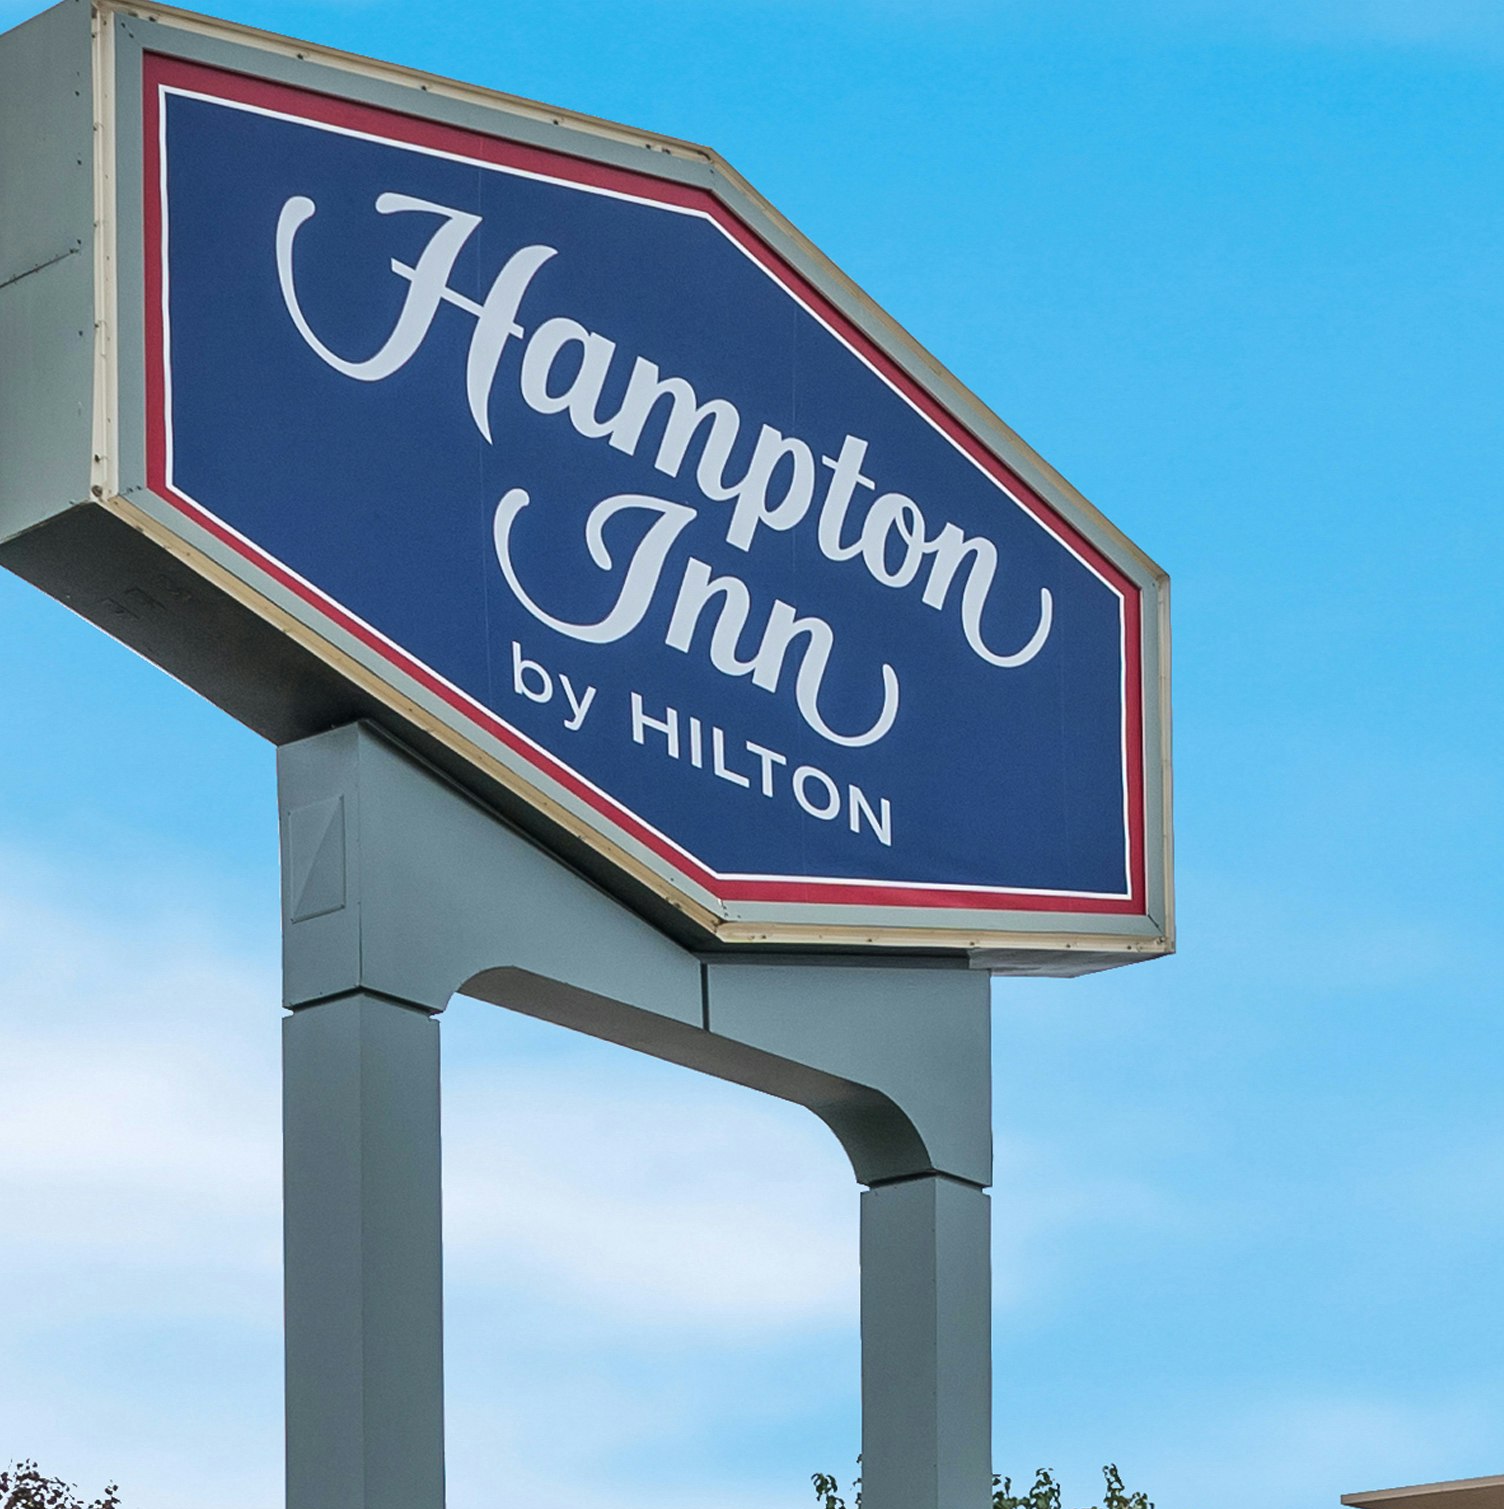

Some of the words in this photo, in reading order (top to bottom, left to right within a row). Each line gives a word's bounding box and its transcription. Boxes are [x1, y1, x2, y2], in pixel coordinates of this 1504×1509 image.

[275, 192, 1052, 667] Hampton
[493, 488, 898, 747] Inn
[512, 641, 596, 731] by
[631, 692, 892, 846] HILTON
